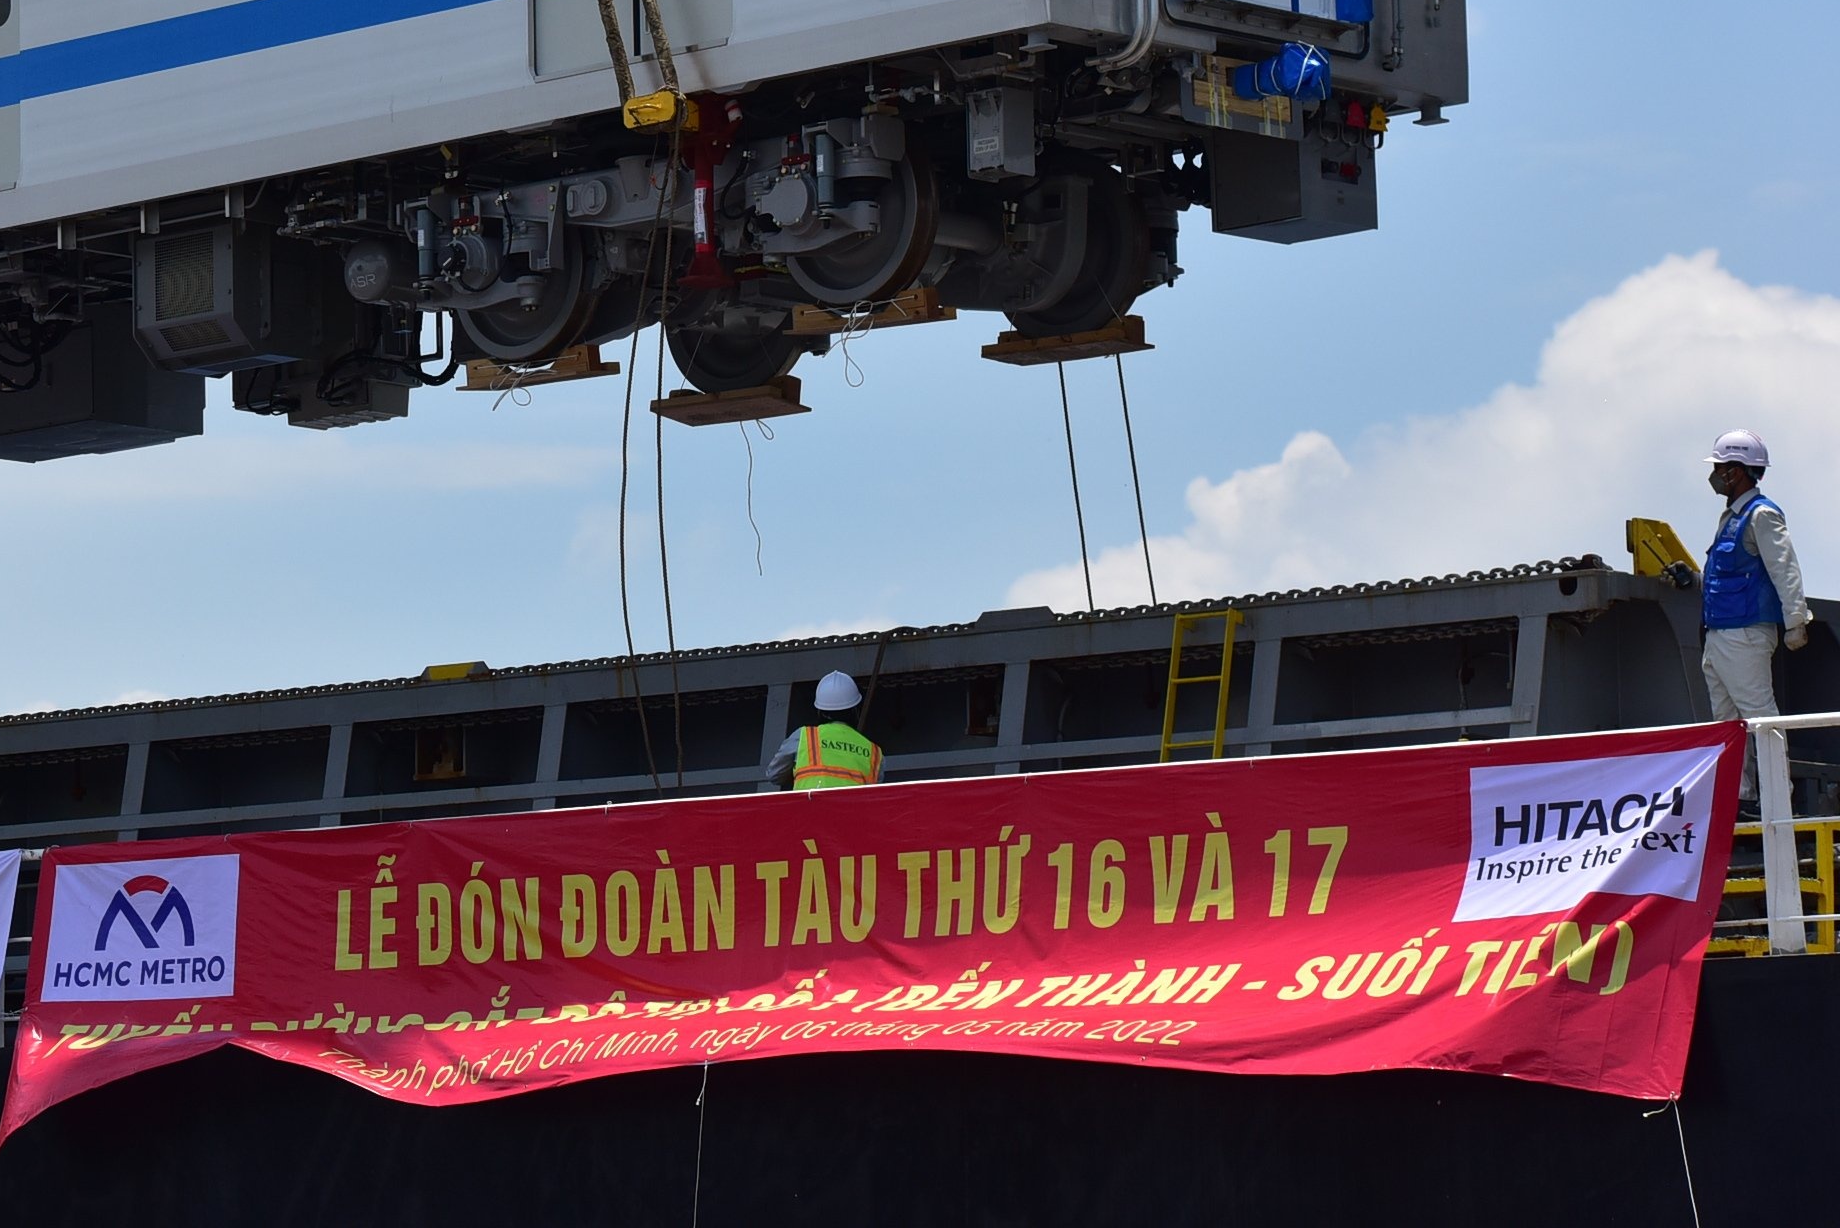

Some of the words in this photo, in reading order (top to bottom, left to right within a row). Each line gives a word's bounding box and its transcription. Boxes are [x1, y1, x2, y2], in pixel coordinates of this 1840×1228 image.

[821, 739, 870, 758] SASTECO
[1494, 786, 1686, 847] HITACH
[1476, 852, 1572, 884] Inspire
[1580, 845, 1622, 870] the
[1631, 822, 1697, 854] ext
[335, 854, 398, 971] LỄ
[416, 861, 543, 967] ĐÓN
[559, 849, 735, 958] ĐOÀN
[756, 838, 878, 947] TÀU
[897, 825, 1033, 939] THỨ
[1048, 838, 1127, 930] 16
[1148, 812, 1235, 924] VÀ
[1264, 825, 1349, 918] 17
[53, 961, 132, 988] HCMC
[139, 955, 226, 985] METRO
[1014, 959, 1243, 1008] THÀNH
[1277, 927, 1452, 1002] SUỐI
[425, 1048, 501, 1096] phố
[489, 1040, 543, 1079] Hồ
[539, 1033, 604, 1070] Chí
[595, 1027, 680, 1061] Minh,
[690, 1021, 784, 1055] ngày
[780, 1020, 837, 1041] 06
[831, 1019, 945, 1042] tháng
[942, 1019, 1005, 1036] 05
[994, 1017, 1086, 1039] năm
[1083, 1019, 1199, 1047] 2022
